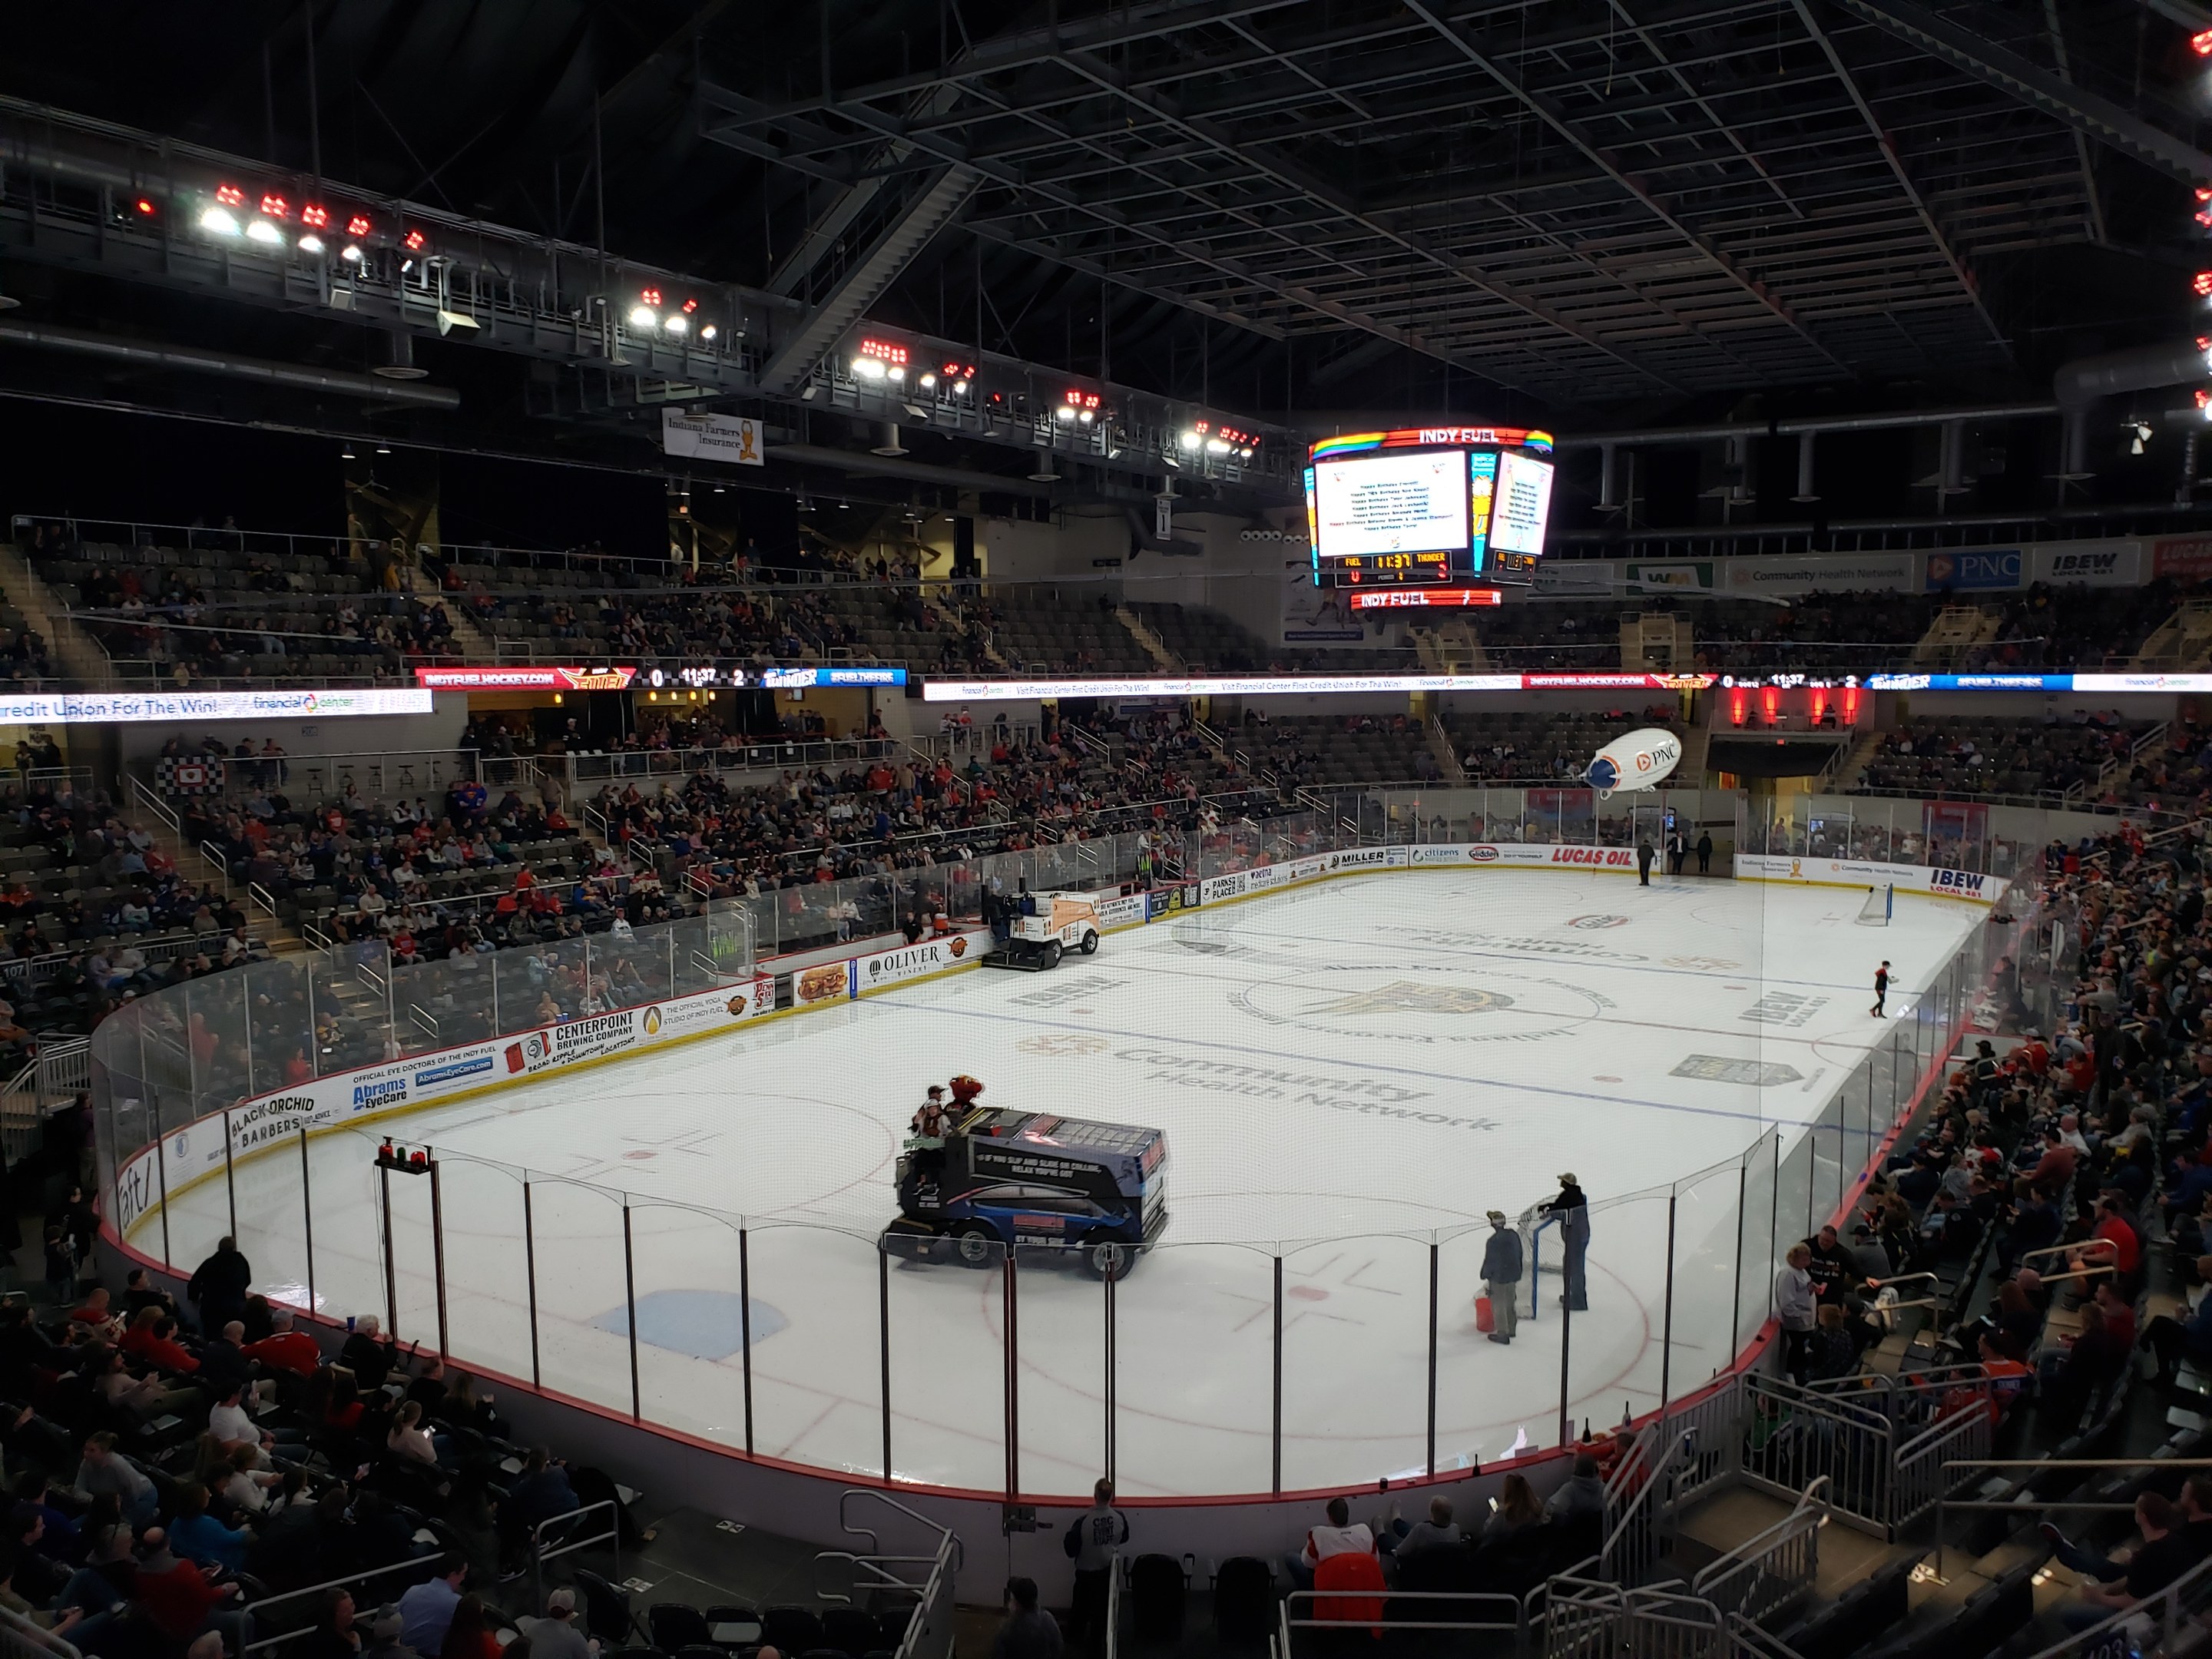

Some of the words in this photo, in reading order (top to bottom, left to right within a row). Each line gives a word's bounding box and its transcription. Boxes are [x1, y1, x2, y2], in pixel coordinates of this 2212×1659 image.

[669, 418, 703, 432] Indiana
[705, 423, 740, 438] Farmers
[1419, 430, 1461, 443] INDY
[1461, 429, 1498, 442] FUEL
[699, 434, 740, 449] Insurance
[1346, 558, 1361, 567] FUEL
[1377, 554, 1410, 568] 11:37
[1416, 553, 1445, 563] THUNDER
[1961, 555, 2021, 578] PNC
[2052, 553, 2118, 570] IBEW
[1647, 573, 1690, 584] WM
[1753, 571, 1815, 581] Community
[1819, 569, 1854, 580] Health
[1857, 568, 1905, 578] Network
[1361, 594, 1387, 607] INDY
[1390, 592, 1429, 606] FUEL
[425, 674, 555, 686] INDYFUELHOCKEY.COM
[651, 670, 663, 687] 0
[682, 668, 717, 682] 11:37
[733, 670, 744, 686] 2
[763, 671, 817, 687] THUNDER
[1723, 675, 1734, 688] 0
[1771, 674, 1805, 685] 11:37
[1845, 675, 1856, 689] 2
[1870, 675, 1930, 690] THUNDER
[1267, 681, 1290, 690] Center
[1310, 680, 1332, 689] Credit
[55, 701, 106, 717] Union
[114, 700, 140, 715] For
[146, 700, 177, 714] The
[180, 699, 217, 714] Win!
[254, 695, 301, 709] financial
[320, 697, 354, 707] center
[1651, 744, 1676, 766] PNC
[1341, 852, 1384, 863] MILLER
[1425, 848, 1459, 857] citizens
[1469, 849, 1499, 859] Glidden
[1551, 848, 1604, 864] LUCAS
[1606, 849, 1632, 866] OIL
[1842, 865, 1873, 873] Community
[1931, 869, 1985, 890] IBEW
[1930, 885, 1962, 895] LOCAL
[1964, 890, 1982, 899] 481
[885, 946, 940, 972] OLIVER
[5, 965, 25, 977] 107
[667, 1005, 678, 1014] THE
[679, 1001, 704, 1012] OFFICIAL
[704, 997, 722, 1008] YOGA
[1737, 991, 1808, 1025] IBEW
[664, 1014, 686, 1025] STUDIO
[686, 1012, 694, 1021] OF
[694, 1009, 708, 1019] INDY
[709, 1006, 724, 1018] FUEL
[557, 1011, 634, 1040] CENTERPOINT
[557, 1034, 594, 1051] BREWING
[596, 1025, 633, 1042] COMPANY
[601, 1037, 636, 1055] LOCATIONS
[528, 1058, 551, 1073] BROAD
[552, 1048, 576, 1063] RIPPLE
[568, 1043, 604, 1065] DOWNTOWN
[353, 1071, 386, 1084] OFFICIAL
[388, 1067, 401, 1076] EYE
[402, 1059, 436, 1072] DOCTORS
[449, 1053, 462, 1061] THE
[463, 1050, 479, 1058] INDY
[481, 1045, 497, 1055] FUEL
[418, 1061, 491, 1084] AbramsEyeCare.com
[1114, 1048, 1434, 1102] Community
[353, 1078, 406, 1104] Abrams
[365, 1091, 407, 1109] EyeCare
[1147, 1069, 1286, 1100] Health
[1294, 1091, 1503, 1132] Network
[232, 1104, 267, 1137] BLACK
[270, 1097, 314, 1114] ORCHID
[242, 1118, 300, 1147] BARBERS
[1012, 1165, 1035, 1174] RELAX
[1092, 1516, 1114, 1526] CSC
[1092, 1526, 1114, 1535] EVENT
[1092, 1535, 1114, 1545] STAFF
